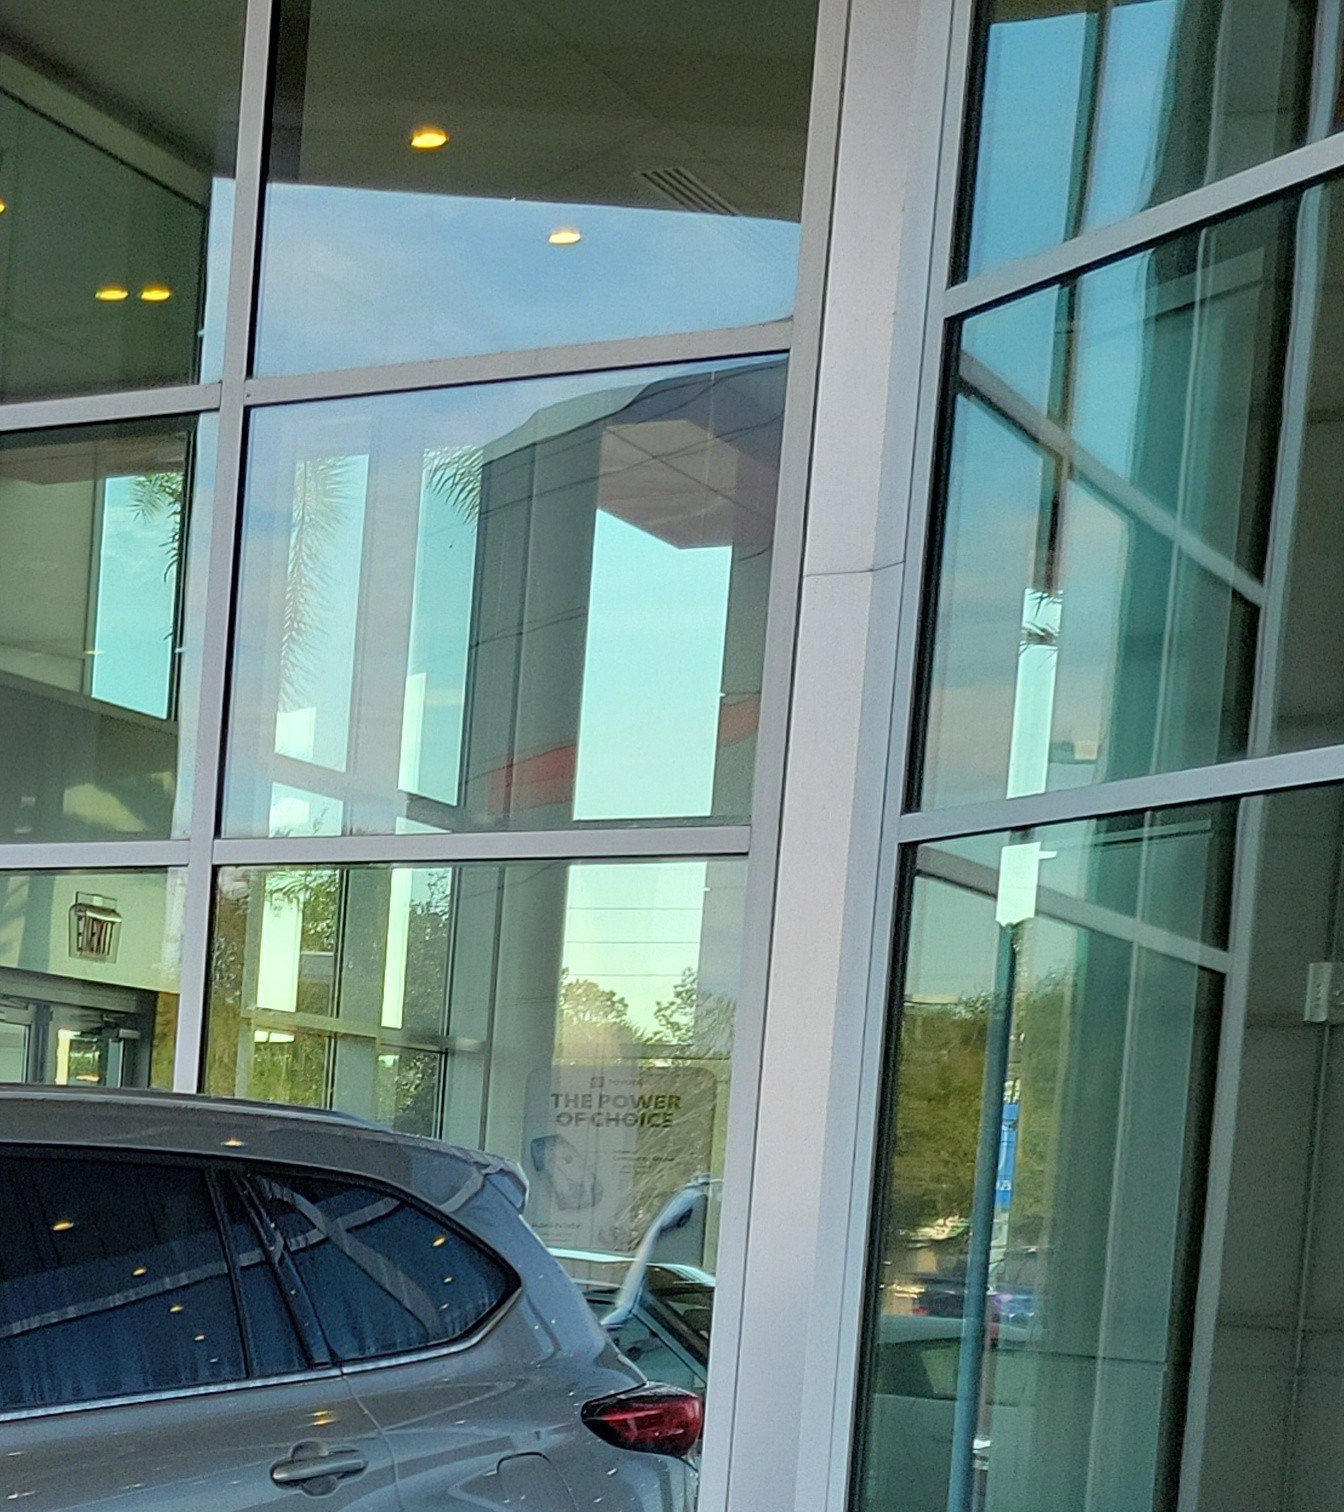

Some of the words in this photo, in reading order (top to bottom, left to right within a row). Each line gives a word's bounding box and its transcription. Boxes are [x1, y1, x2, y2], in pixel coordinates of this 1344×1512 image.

[551, 1093, 592, 1109] THE
[598, 1094, 682, 1110] POWER
[556, 1112, 587, 1127] OF
[591, 1112, 674, 1128] CHOICE
